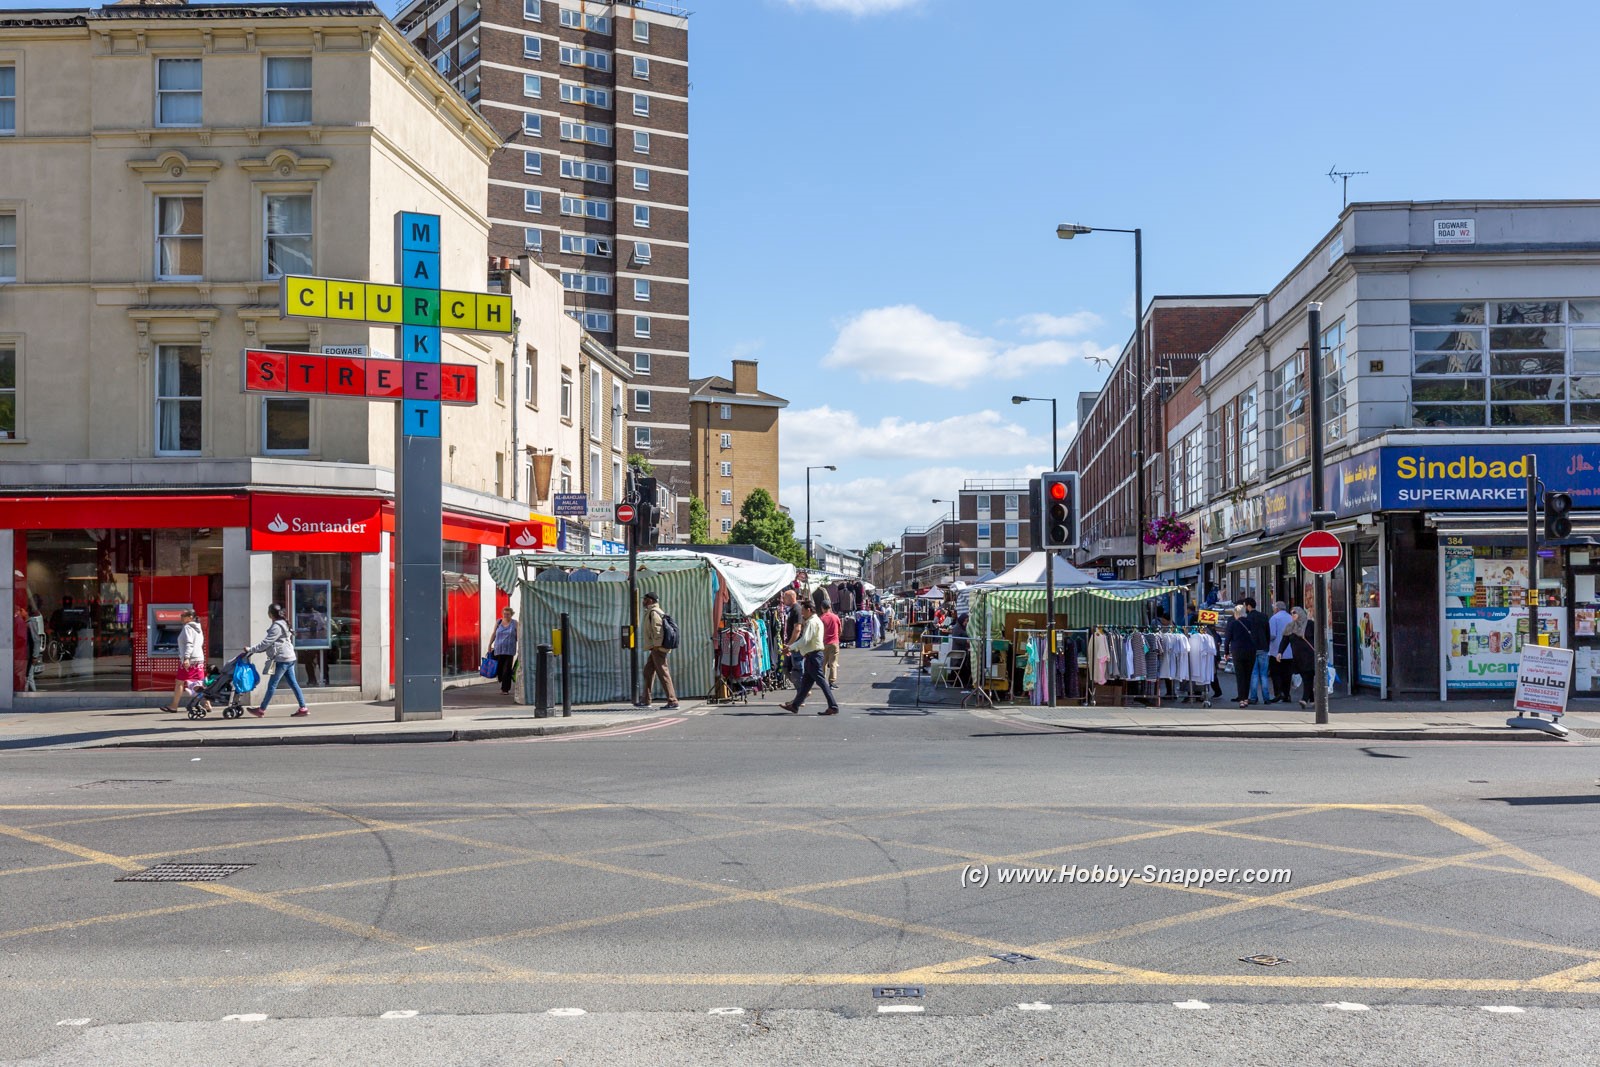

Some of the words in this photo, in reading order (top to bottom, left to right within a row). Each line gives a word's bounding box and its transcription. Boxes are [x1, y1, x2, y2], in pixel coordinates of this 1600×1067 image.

[299, 288, 501, 323] CHURCH
[412, 223, 430, 428] MARKET
[260, 362, 465, 392] STREET
[1397, 455, 1527, 479] Sindbad
[1398, 488, 1527, 501] SUPERMARKET
[292, 517, 367, 533] Santander
[1447, 537, 1463, 545] 384
[1200, 612, 1216, 621] £2
